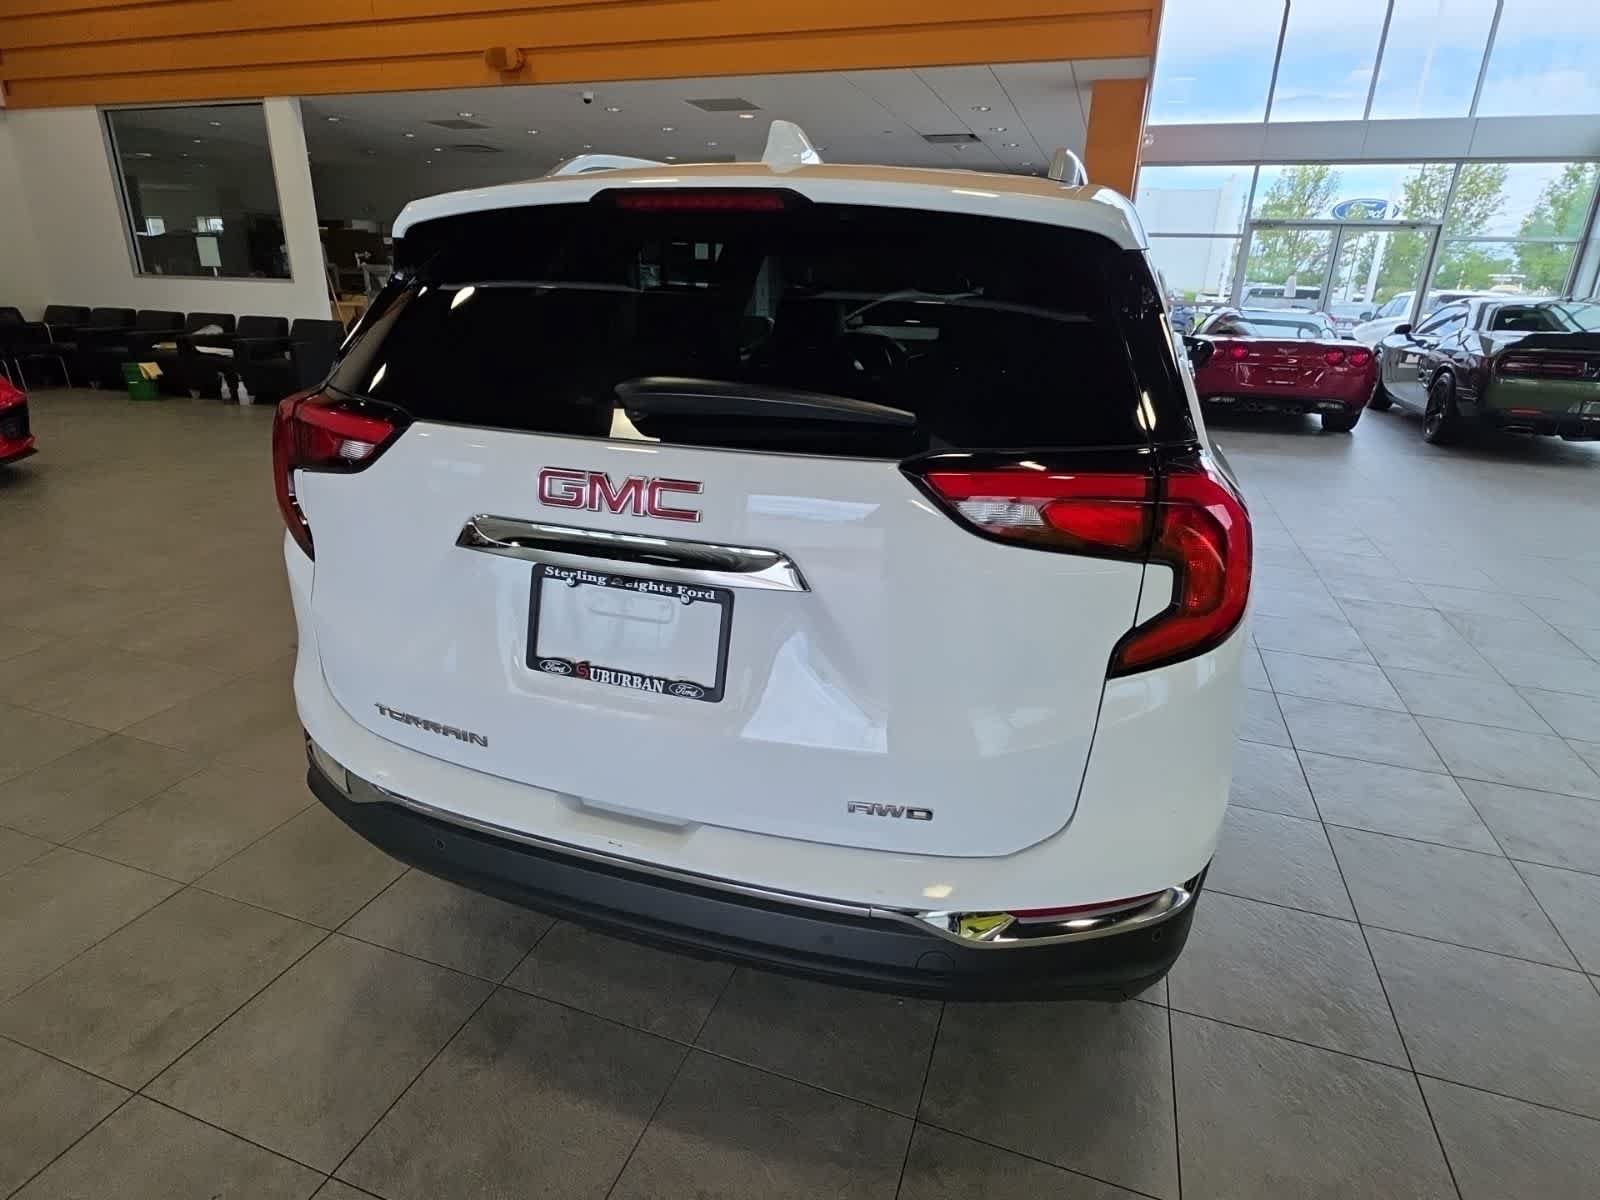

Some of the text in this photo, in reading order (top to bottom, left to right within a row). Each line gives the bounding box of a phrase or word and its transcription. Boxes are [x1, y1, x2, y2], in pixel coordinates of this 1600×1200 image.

[538, 466, 704, 523] GMC
[544, 566, 716, 601] Sterling eights Ford
[576, 663, 665, 693] SUBURBAN
[374, 702, 488, 748] TERRAIN
[847, 800, 933, 821] AWD
